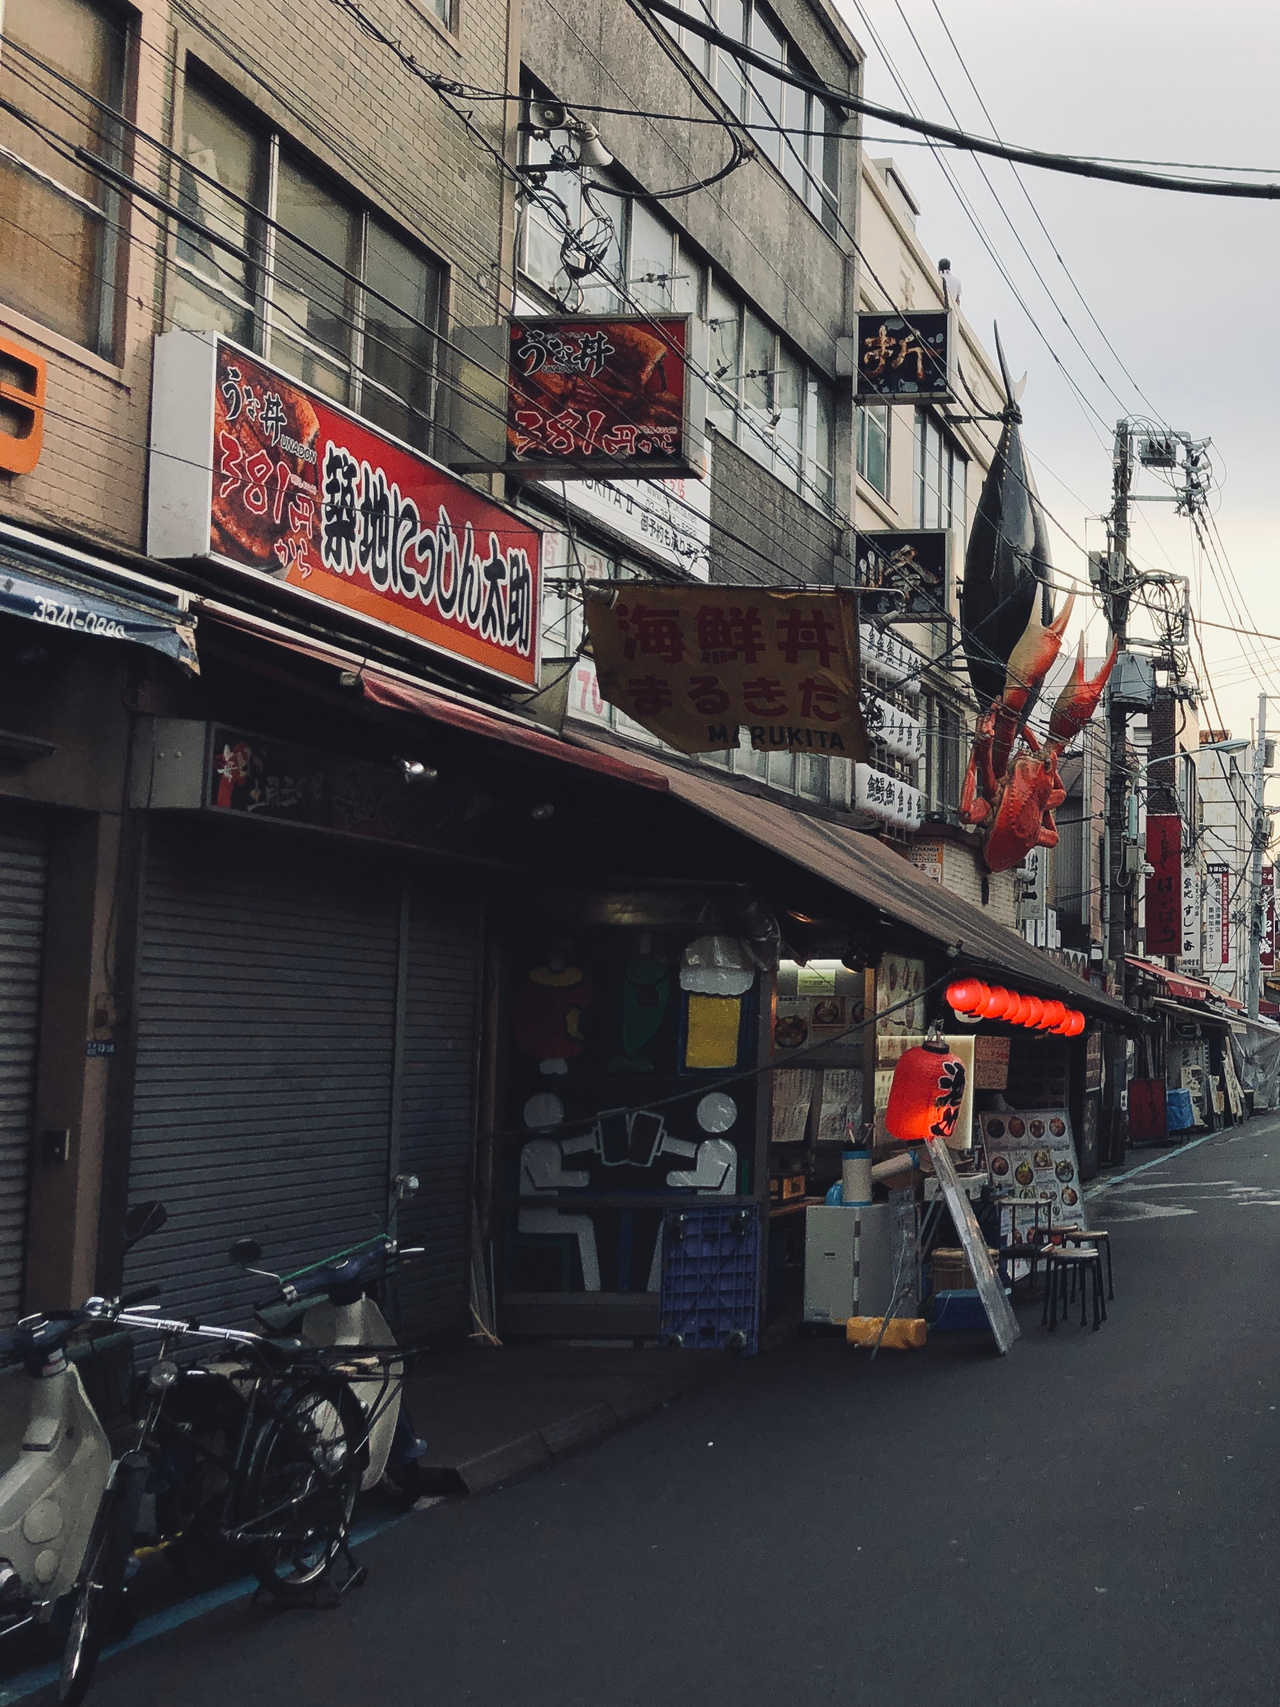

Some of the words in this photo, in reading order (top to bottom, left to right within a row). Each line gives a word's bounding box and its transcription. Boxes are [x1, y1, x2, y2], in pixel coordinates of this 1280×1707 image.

[614, 603, 840, 669] 海鮮丼
[626, 674, 843, 722] まるきた
